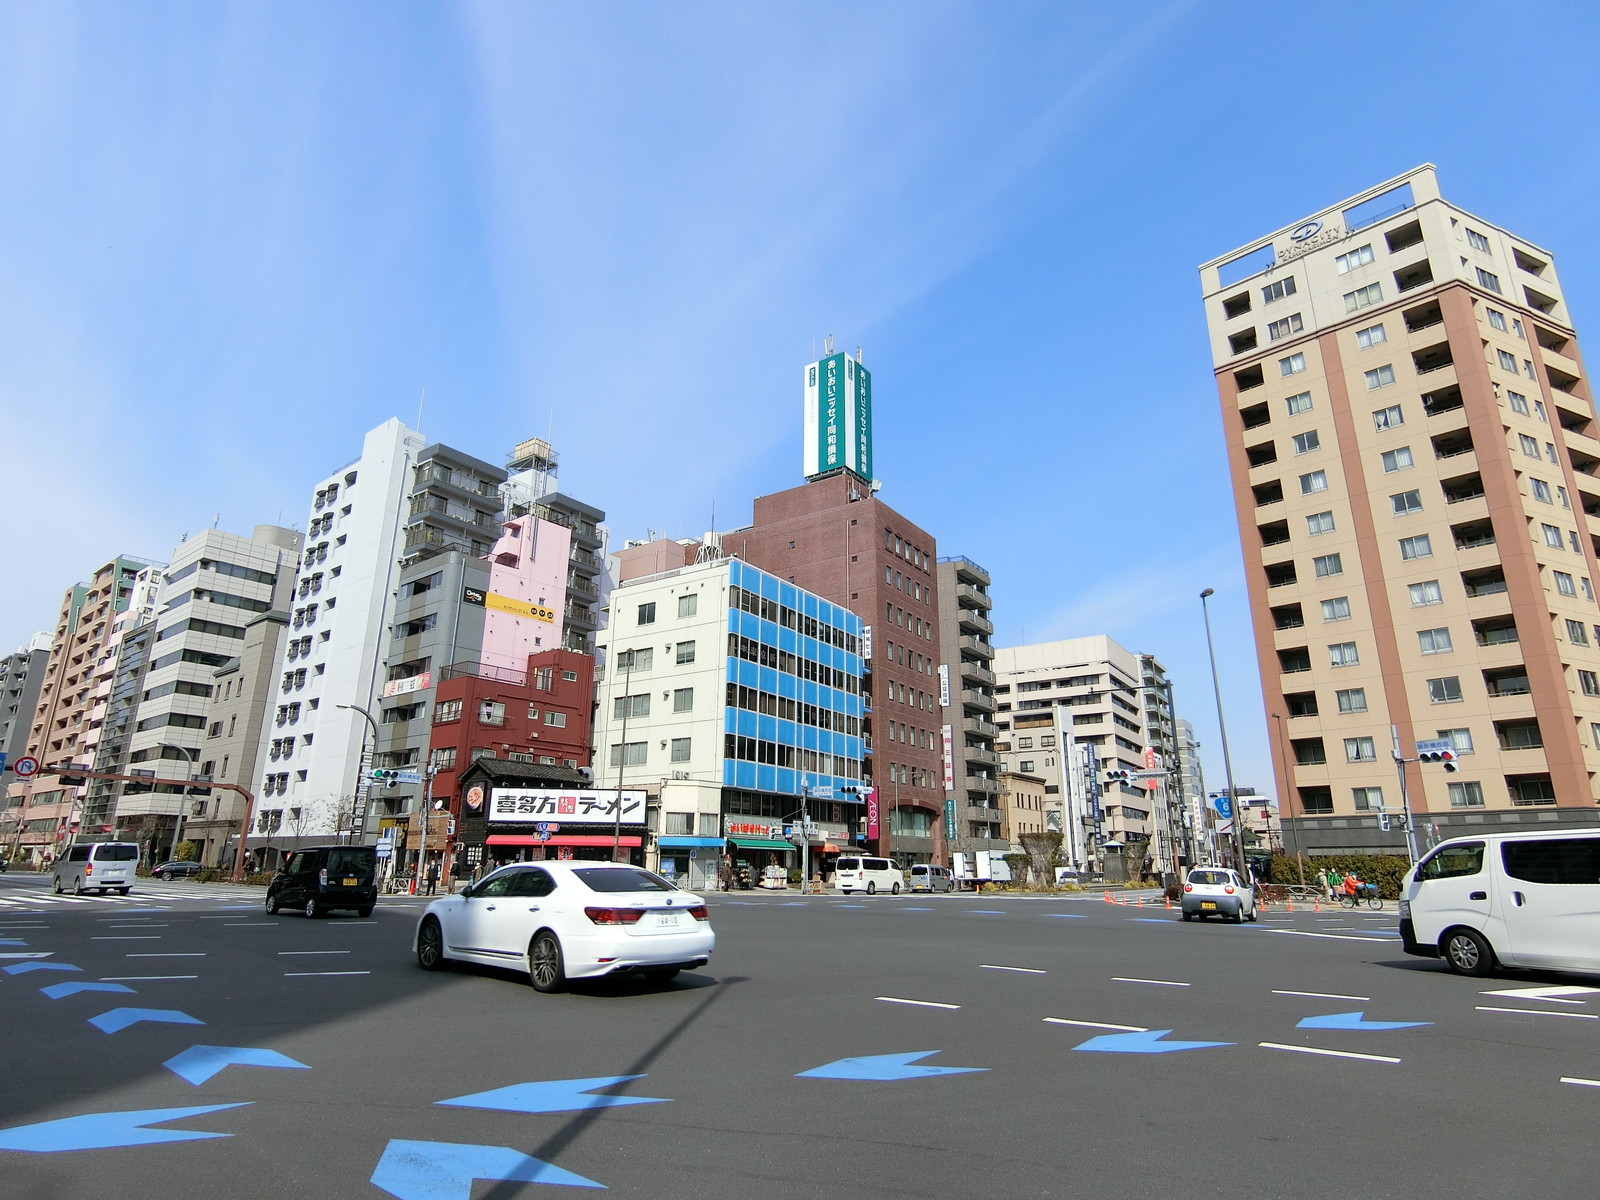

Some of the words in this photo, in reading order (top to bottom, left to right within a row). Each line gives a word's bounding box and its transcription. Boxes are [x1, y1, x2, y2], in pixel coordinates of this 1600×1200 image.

[1277, 224, 1341, 259] DYNACITY
[827, 359, 837, 465] あいおいニッセイ同和損保
[496, 795, 557, 814] 喜多方
[578, 796, 641, 815] ラーメン
[1222, 802, 1230, 811] 6
